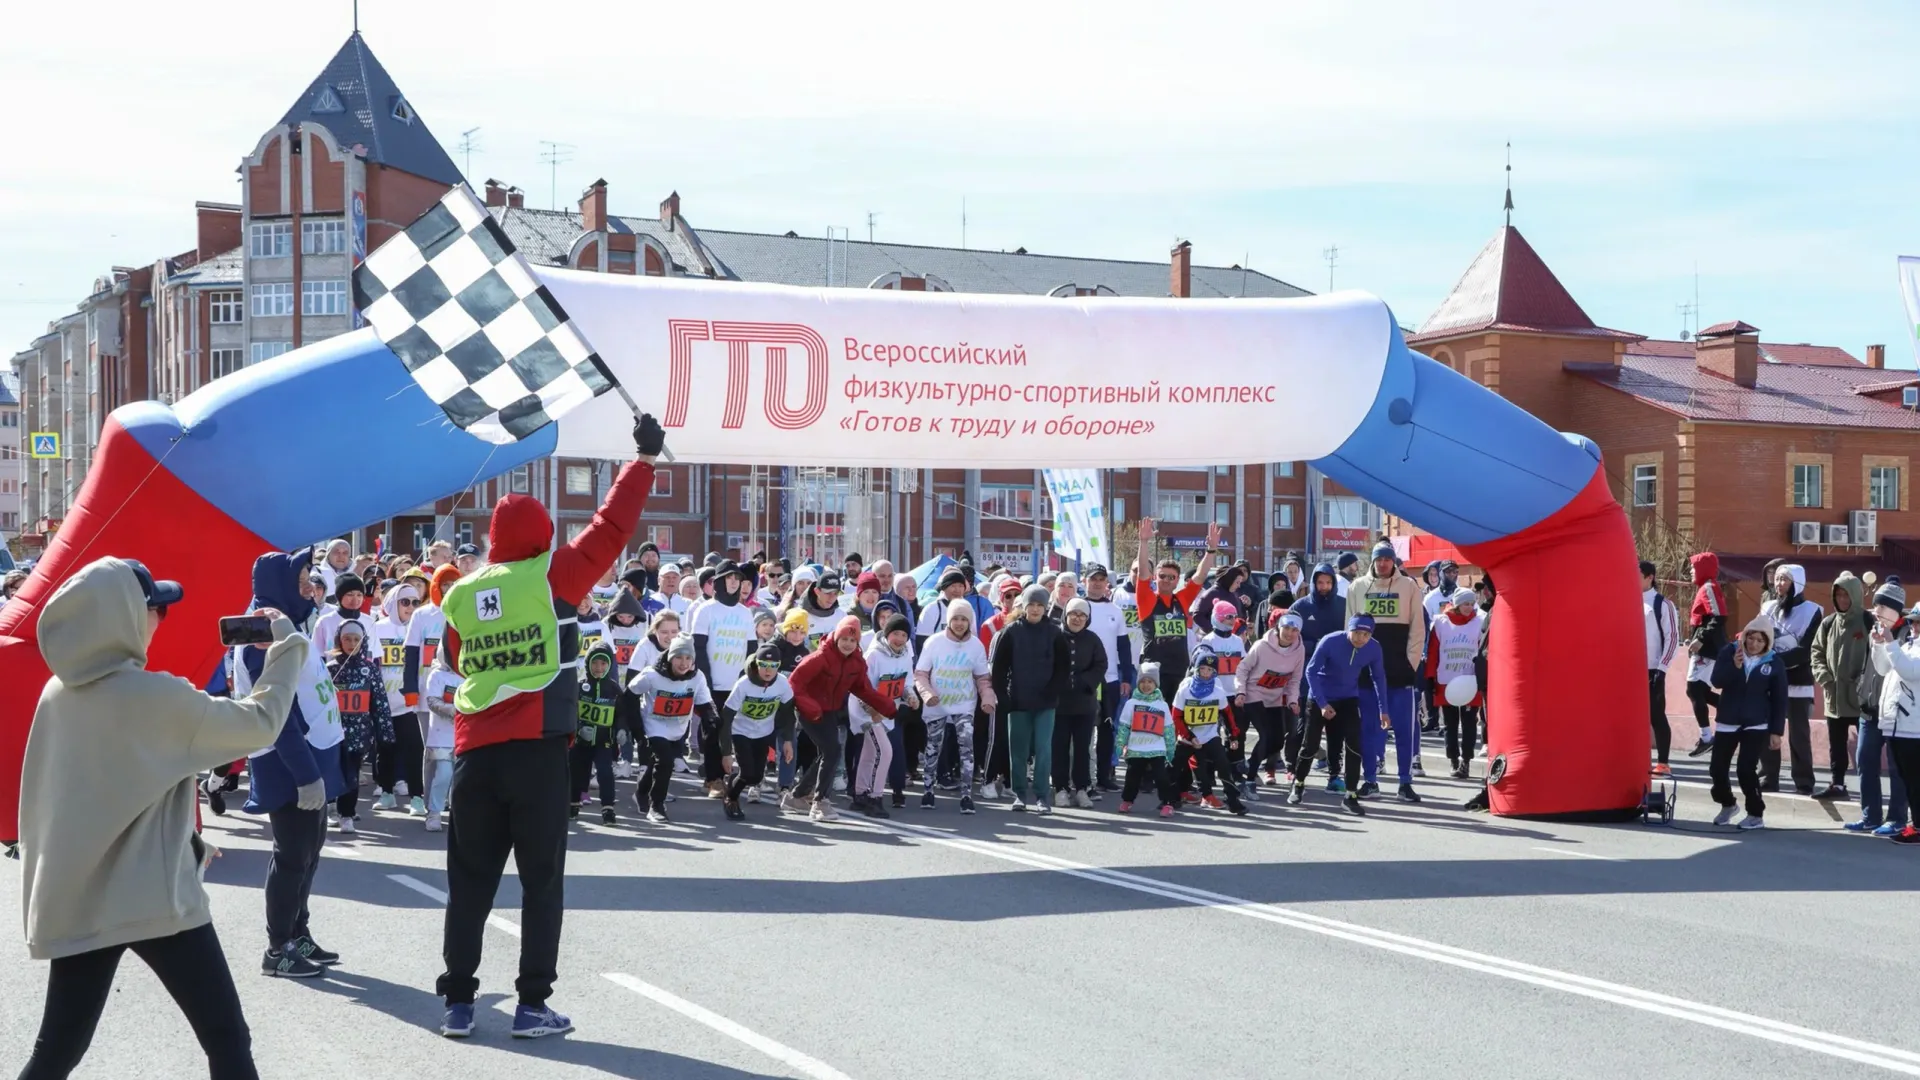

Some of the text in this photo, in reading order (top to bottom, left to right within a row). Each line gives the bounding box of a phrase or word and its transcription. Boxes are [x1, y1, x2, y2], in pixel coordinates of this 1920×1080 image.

[844, 337, 1027, 368] Всероссийский
[664, 319, 829, 429] ГТО
[844, 374, 1276, 408] физкультурно-спортивный комплекс
[839, 410, 1155, 440] «Готов к труду и обороне»
[1369, 600, 1396, 615] 256
[1158, 621, 1183, 635] 345
[462, 623, 542, 654] ЛАВНЫЙ
[886, 681, 901, 697] 16
[342, 692, 361, 711] 10
[664, 700, 684, 714] 67
[746, 703, 776, 717] 229
[580, 703, 610, 724] 201
[1142, 714, 1158, 731] 17
[1190, 707, 1215, 723] 147
